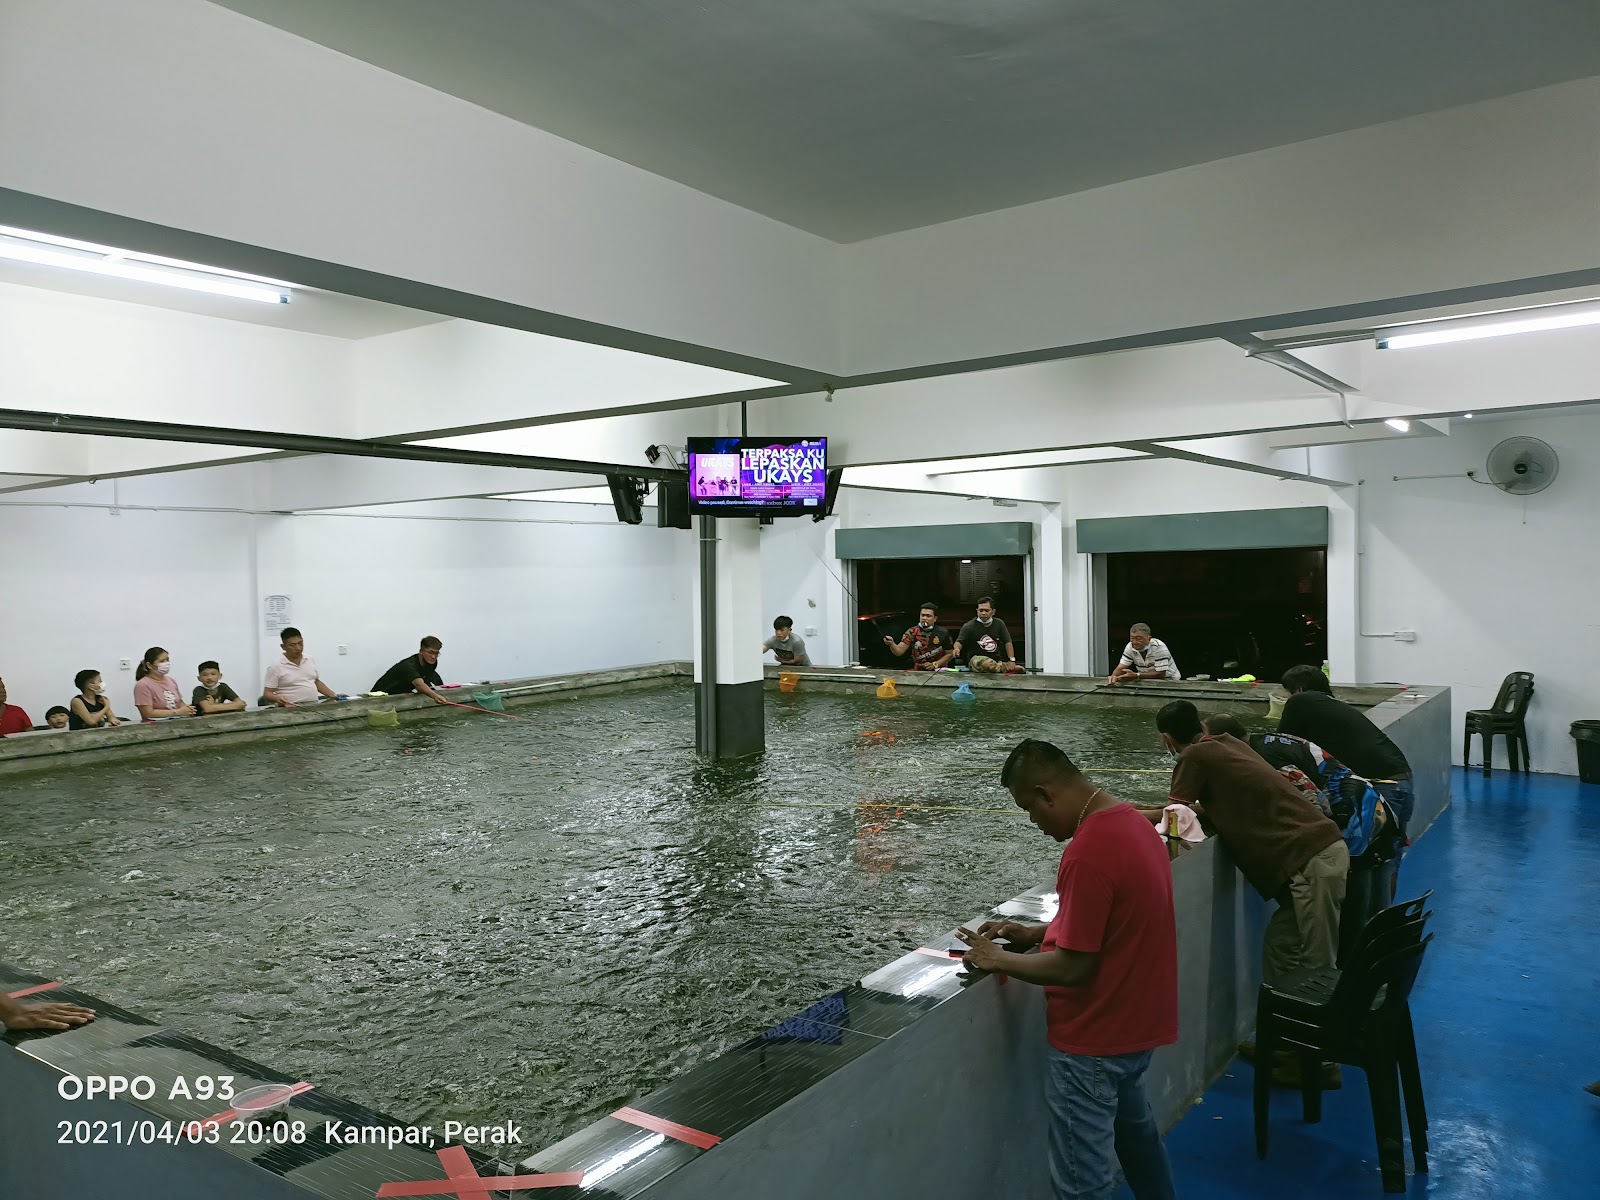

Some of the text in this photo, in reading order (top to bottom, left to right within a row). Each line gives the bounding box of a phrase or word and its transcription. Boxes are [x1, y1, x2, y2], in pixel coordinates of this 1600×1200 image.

[741, 449, 824, 458] TERPAKSA KU
[741, 458, 824, 470] LEPASKAN
[754, 469, 813, 483] UKAYS
